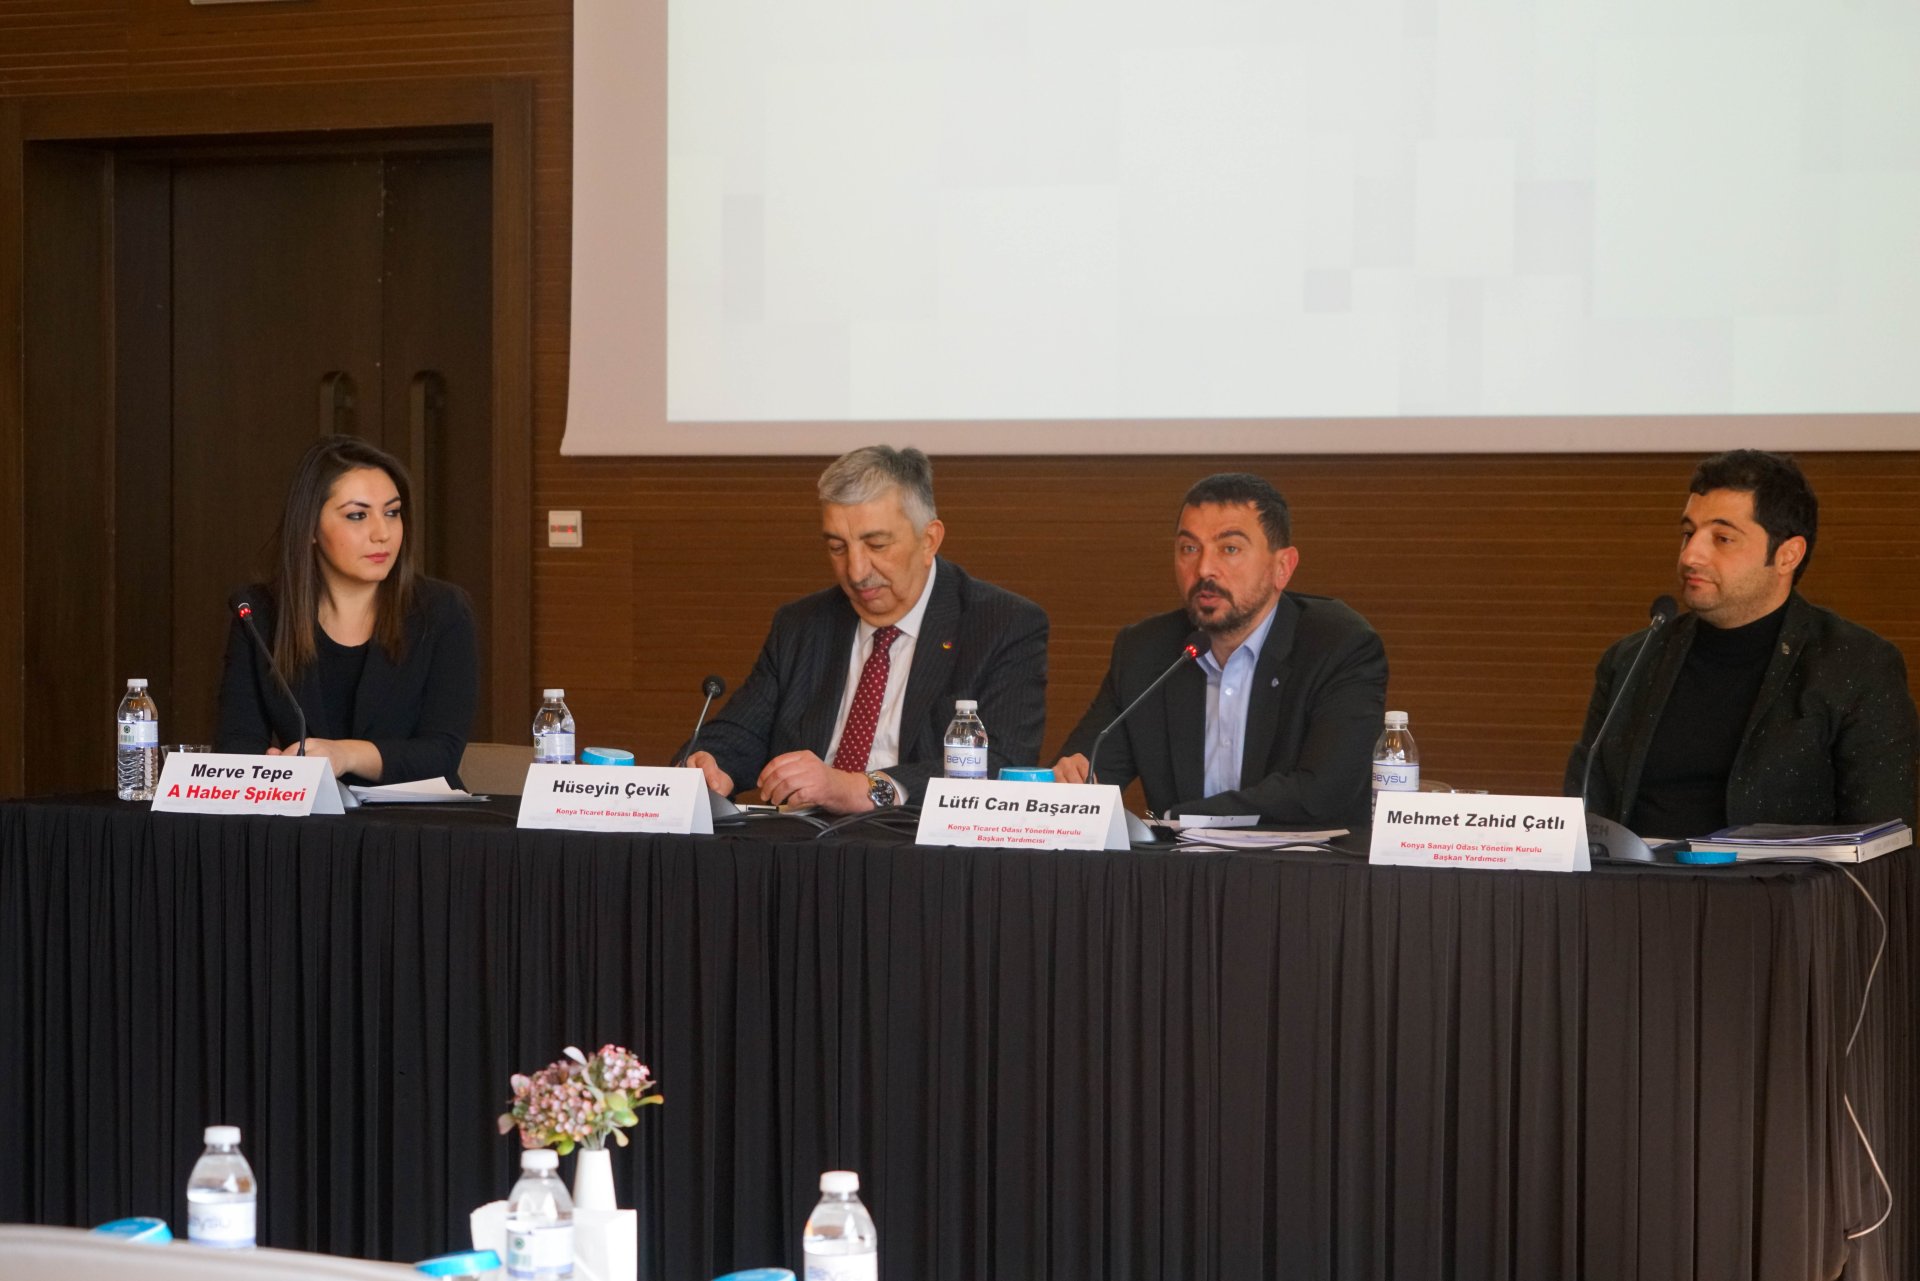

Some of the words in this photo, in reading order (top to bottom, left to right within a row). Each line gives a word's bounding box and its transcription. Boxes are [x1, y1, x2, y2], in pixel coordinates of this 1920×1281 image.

[191, 763, 244, 779] Merve
[251, 765, 293, 783] Tepe
[167, 783, 180, 798] A
[186, 784, 240, 801] Haber
[244, 786, 306, 804] Spikeri
[552, 779, 619, 798] Hüseyin
[625, 782, 670, 799] Çevik
[556, 807, 577, 815] Konya
[579, 808, 604, 816] Ticaret
[605, 809, 631, 817] Borsası
[938, 794, 980, 810] Lütfi
[985, 797, 1020, 812] Can
[1025, 798, 1101, 816] Başaran
[1387, 810, 1460, 827] Mehmet
[1465, 813, 1517, 829] Zahid
[1523, 814, 1565, 832] Çatlı
[947, 823, 971, 832] Konya
[973, 825, 999, 833] Ticaret
[1001, 826, 1022, 834] Odası
[1024, 826, 1055, 836] Yönetim
[977, 835, 1005, 843] Başkan
[1400, 841, 1426, 850] Konya
[1427, 842, 1455, 851] Sanayi
[1455, 843, 1479, 851] Odası
[1480, 844, 1514, 853] Yönetim
[1515, 845, 1543, 854] Kurulu
[1433, 853, 1463, 863] Başkan
